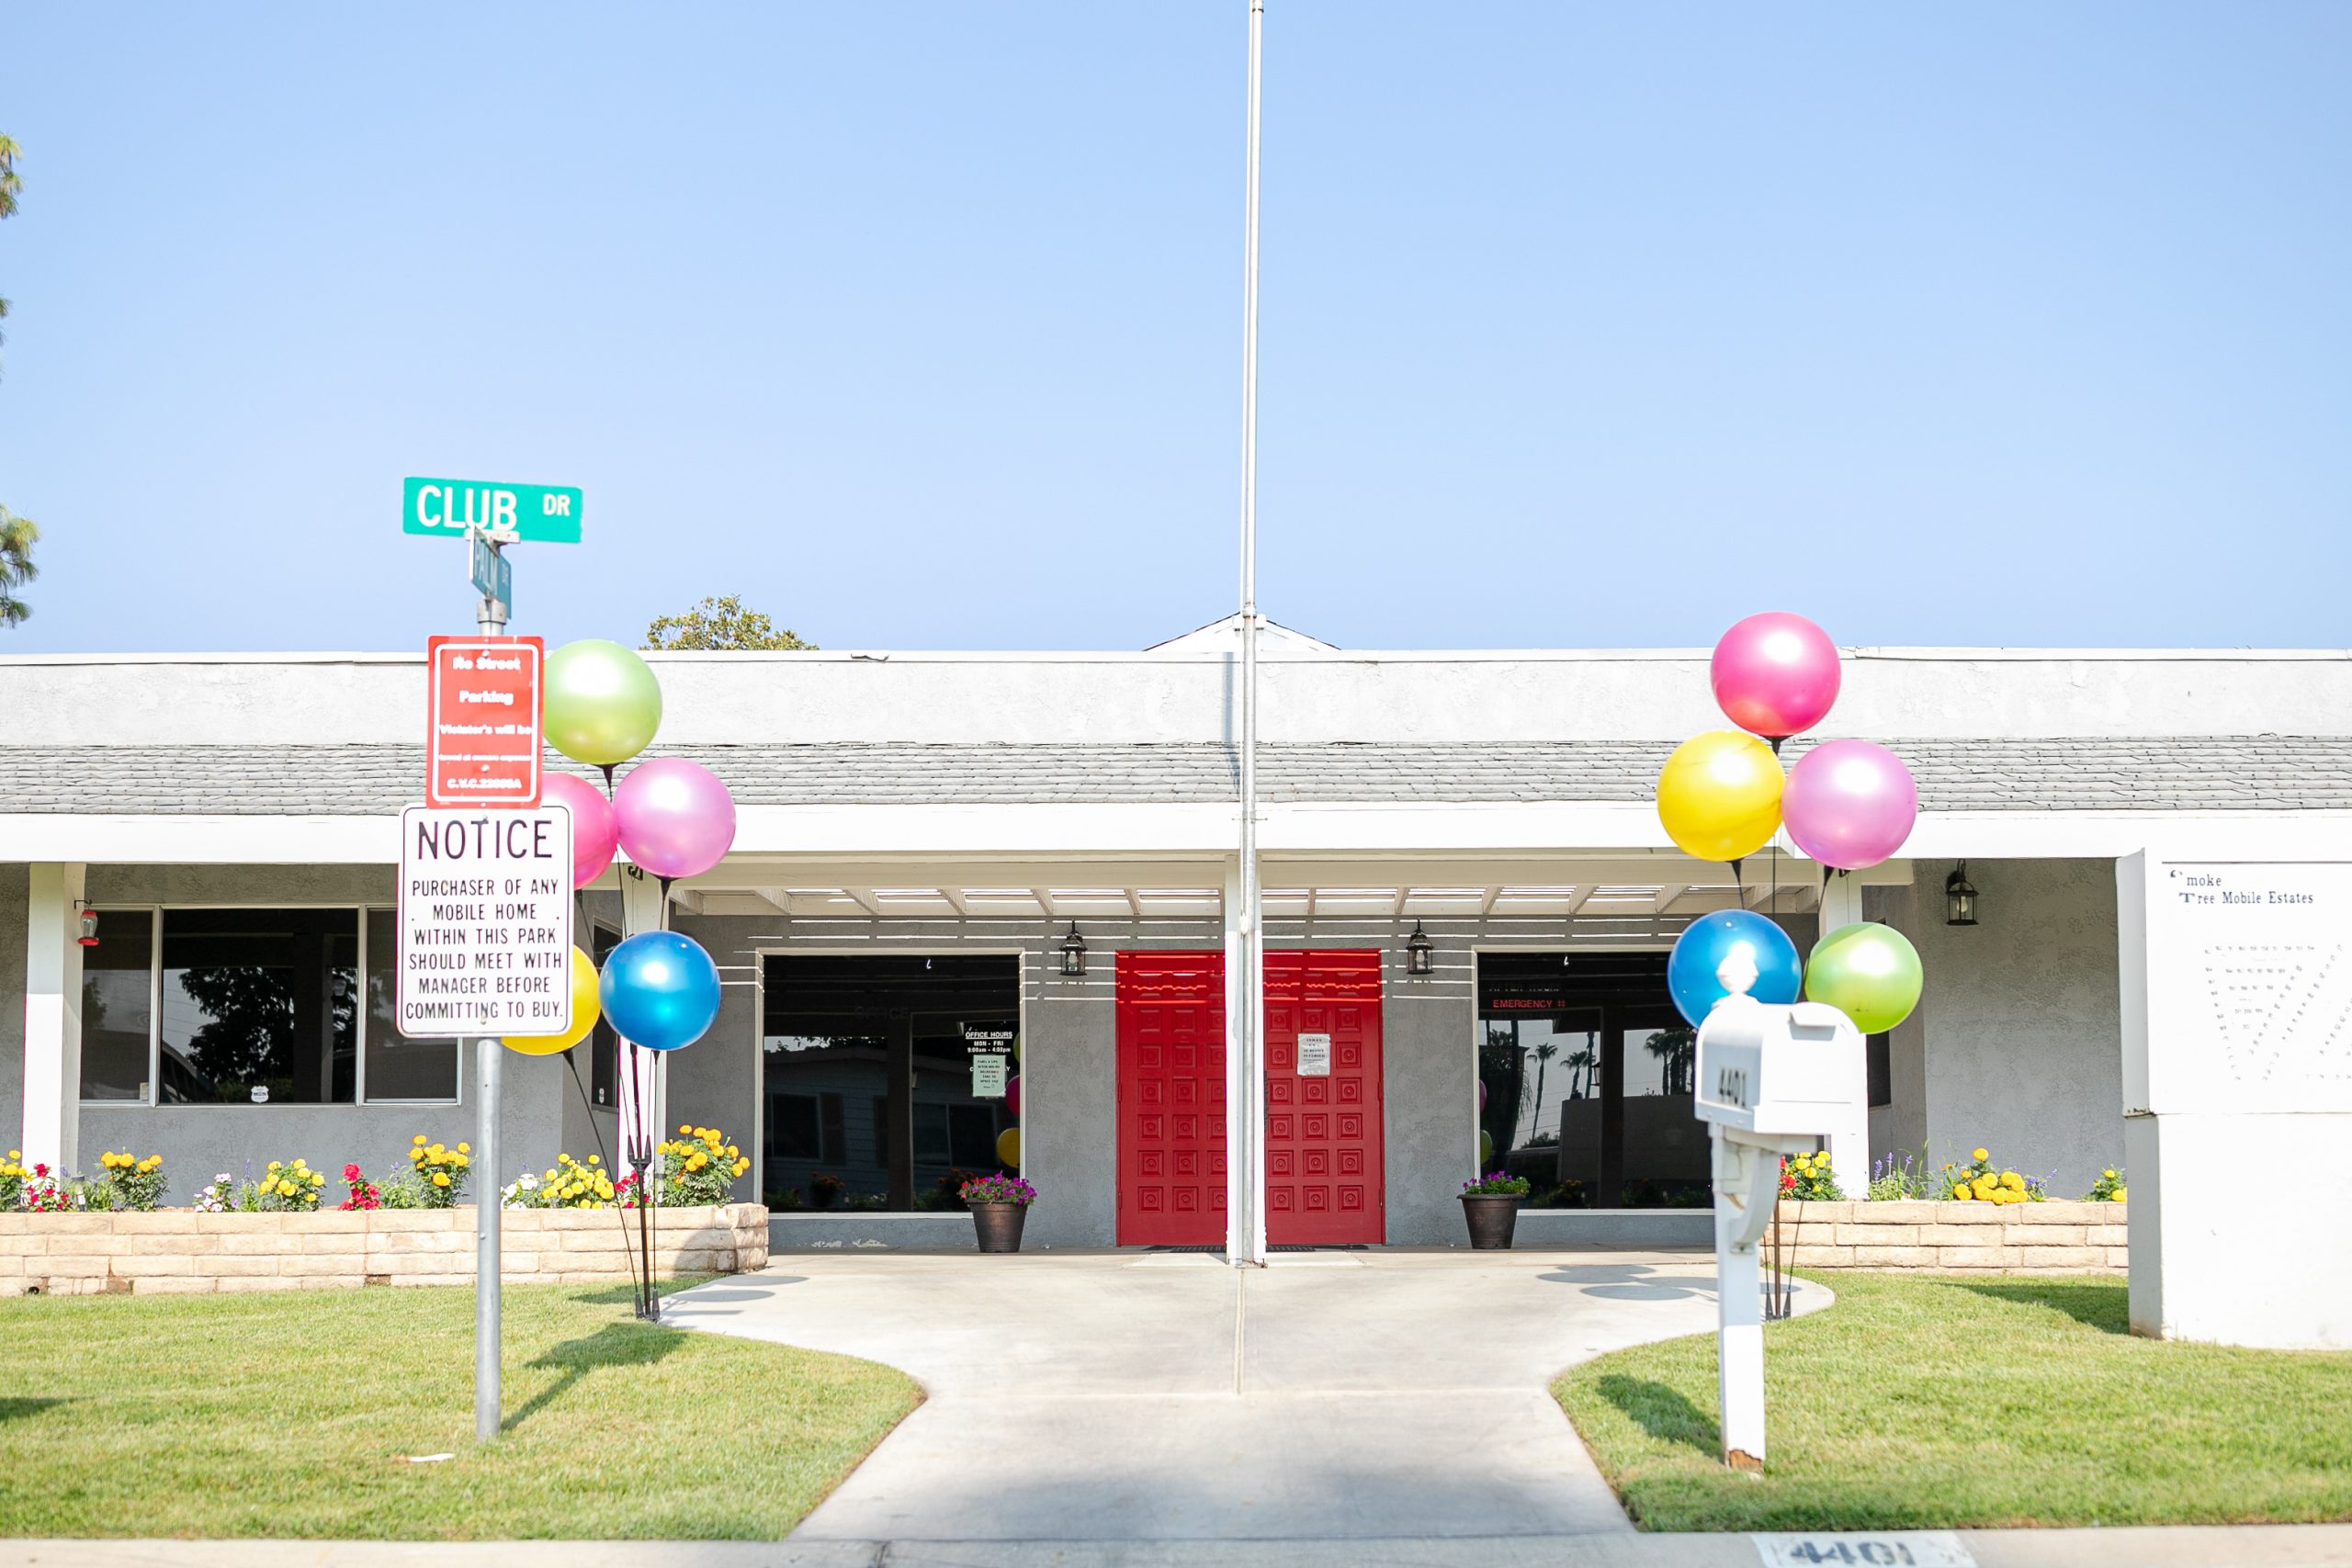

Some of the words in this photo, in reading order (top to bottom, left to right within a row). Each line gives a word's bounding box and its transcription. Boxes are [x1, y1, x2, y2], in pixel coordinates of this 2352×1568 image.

[417, 485, 517, 530] CLUB
[543, 493, 571, 516] DR
[453, 656, 473, 670] No
[476, 655, 521, 670] Street
[458, 691, 514, 705] Parking
[417, 818, 552, 860] NOTICE
[2170, 869, 2222, 886] moke
[413, 879, 494, 897] PURCHASER
[504, 879, 522, 896] OF
[530, 879, 559, 895] ANY
[2178, 891, 2215, 904] Tree
[2222, 891, 2262, 904] Mobile
[2268, 891, 2314, 904] Estates
[433, 903, 485, 920] MOBILE
[495, 903, 537, 919] HOME
[414, 928, 466, 945] WITHIN
[476, 928, 508, 944] THIS
[518, 928, 556, 944] PARK
[409, 953, 466, 970] SHOULD
[475, 953, 514, 969] MEET
[524, 952, 561, 968] WITH
[418, 977, 487, 994] MANAGER
[496, 976, 550, 993] BEFORE
[405, 1002, 499, 1020] COMMITTING
[507, 1001, 525, 1017] TO
[532, 1001, 563, 1017] BUY.
[1493, 999, 1553, 1008] EMERGENCY
[1718, 1067, 1747, 1107] 4401
[1791, 1541, 1917, 1565] 4401
